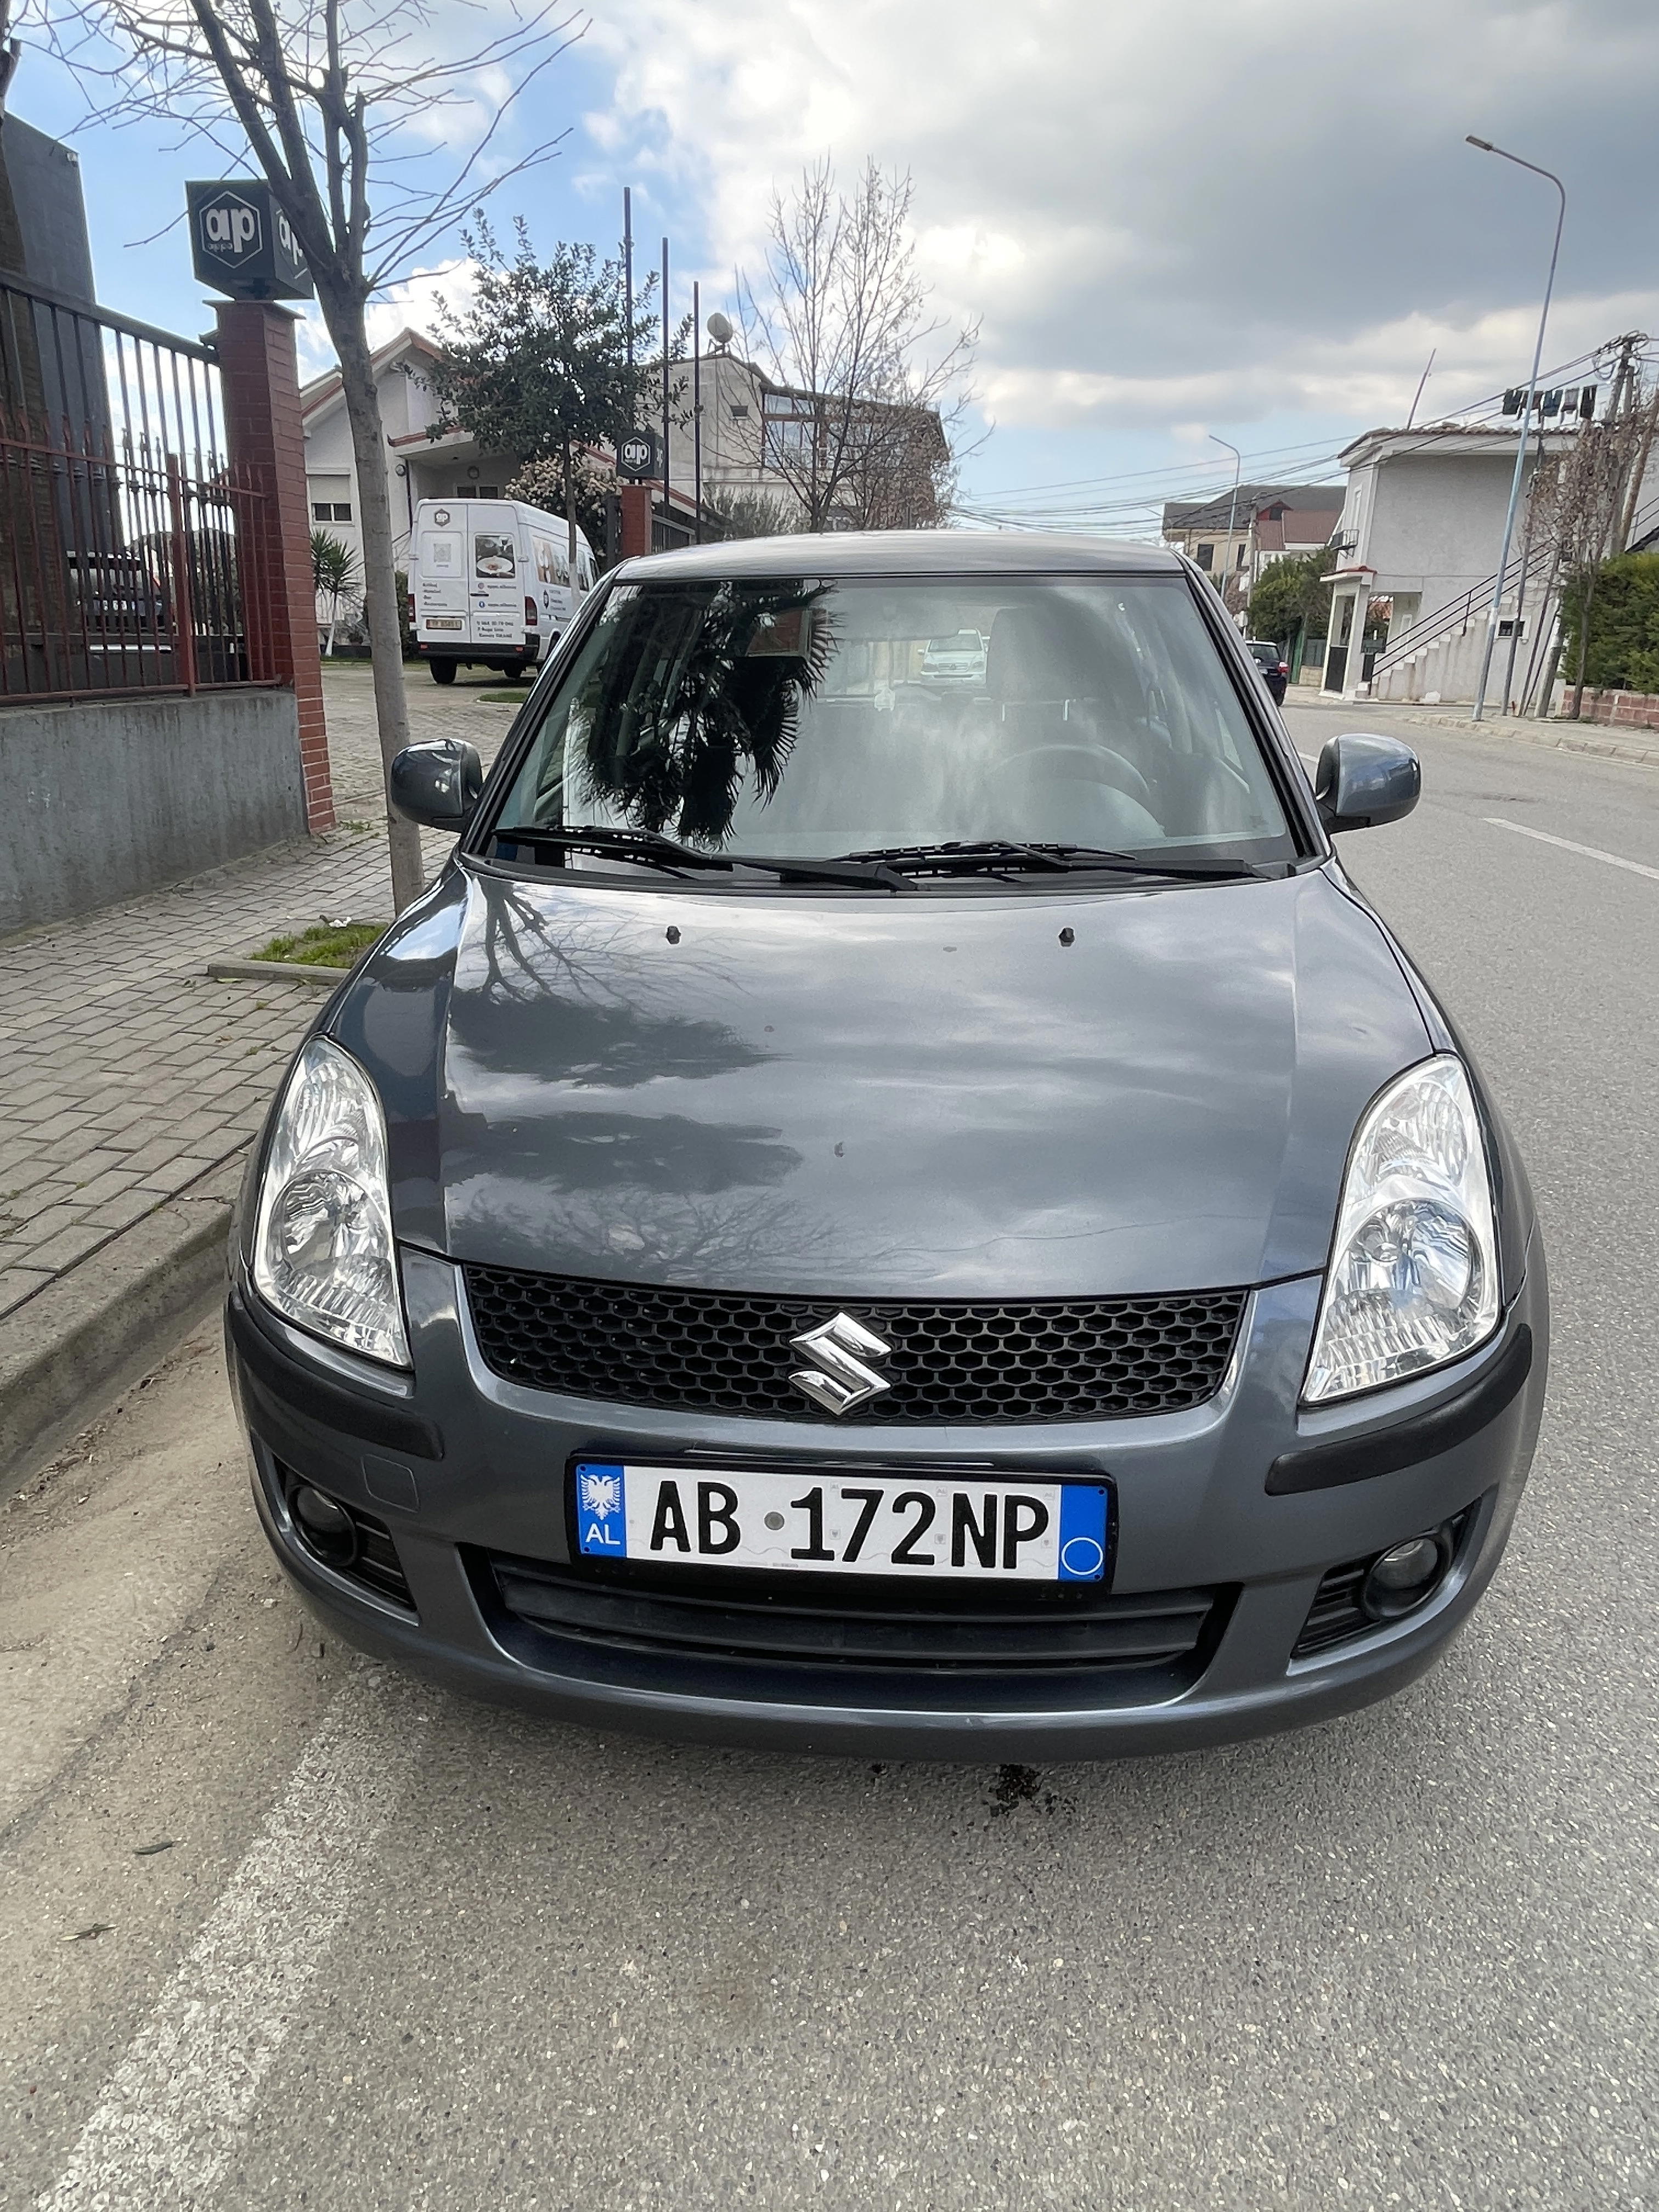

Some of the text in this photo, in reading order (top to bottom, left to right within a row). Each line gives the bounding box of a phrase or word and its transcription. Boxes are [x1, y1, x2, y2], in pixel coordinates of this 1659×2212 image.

[206, 208, 255, 253] ap
[625, 445, 647, 465] ap
[650, 1480, 741, 1554] AB
[585, 1523, 620, 1545] AL
